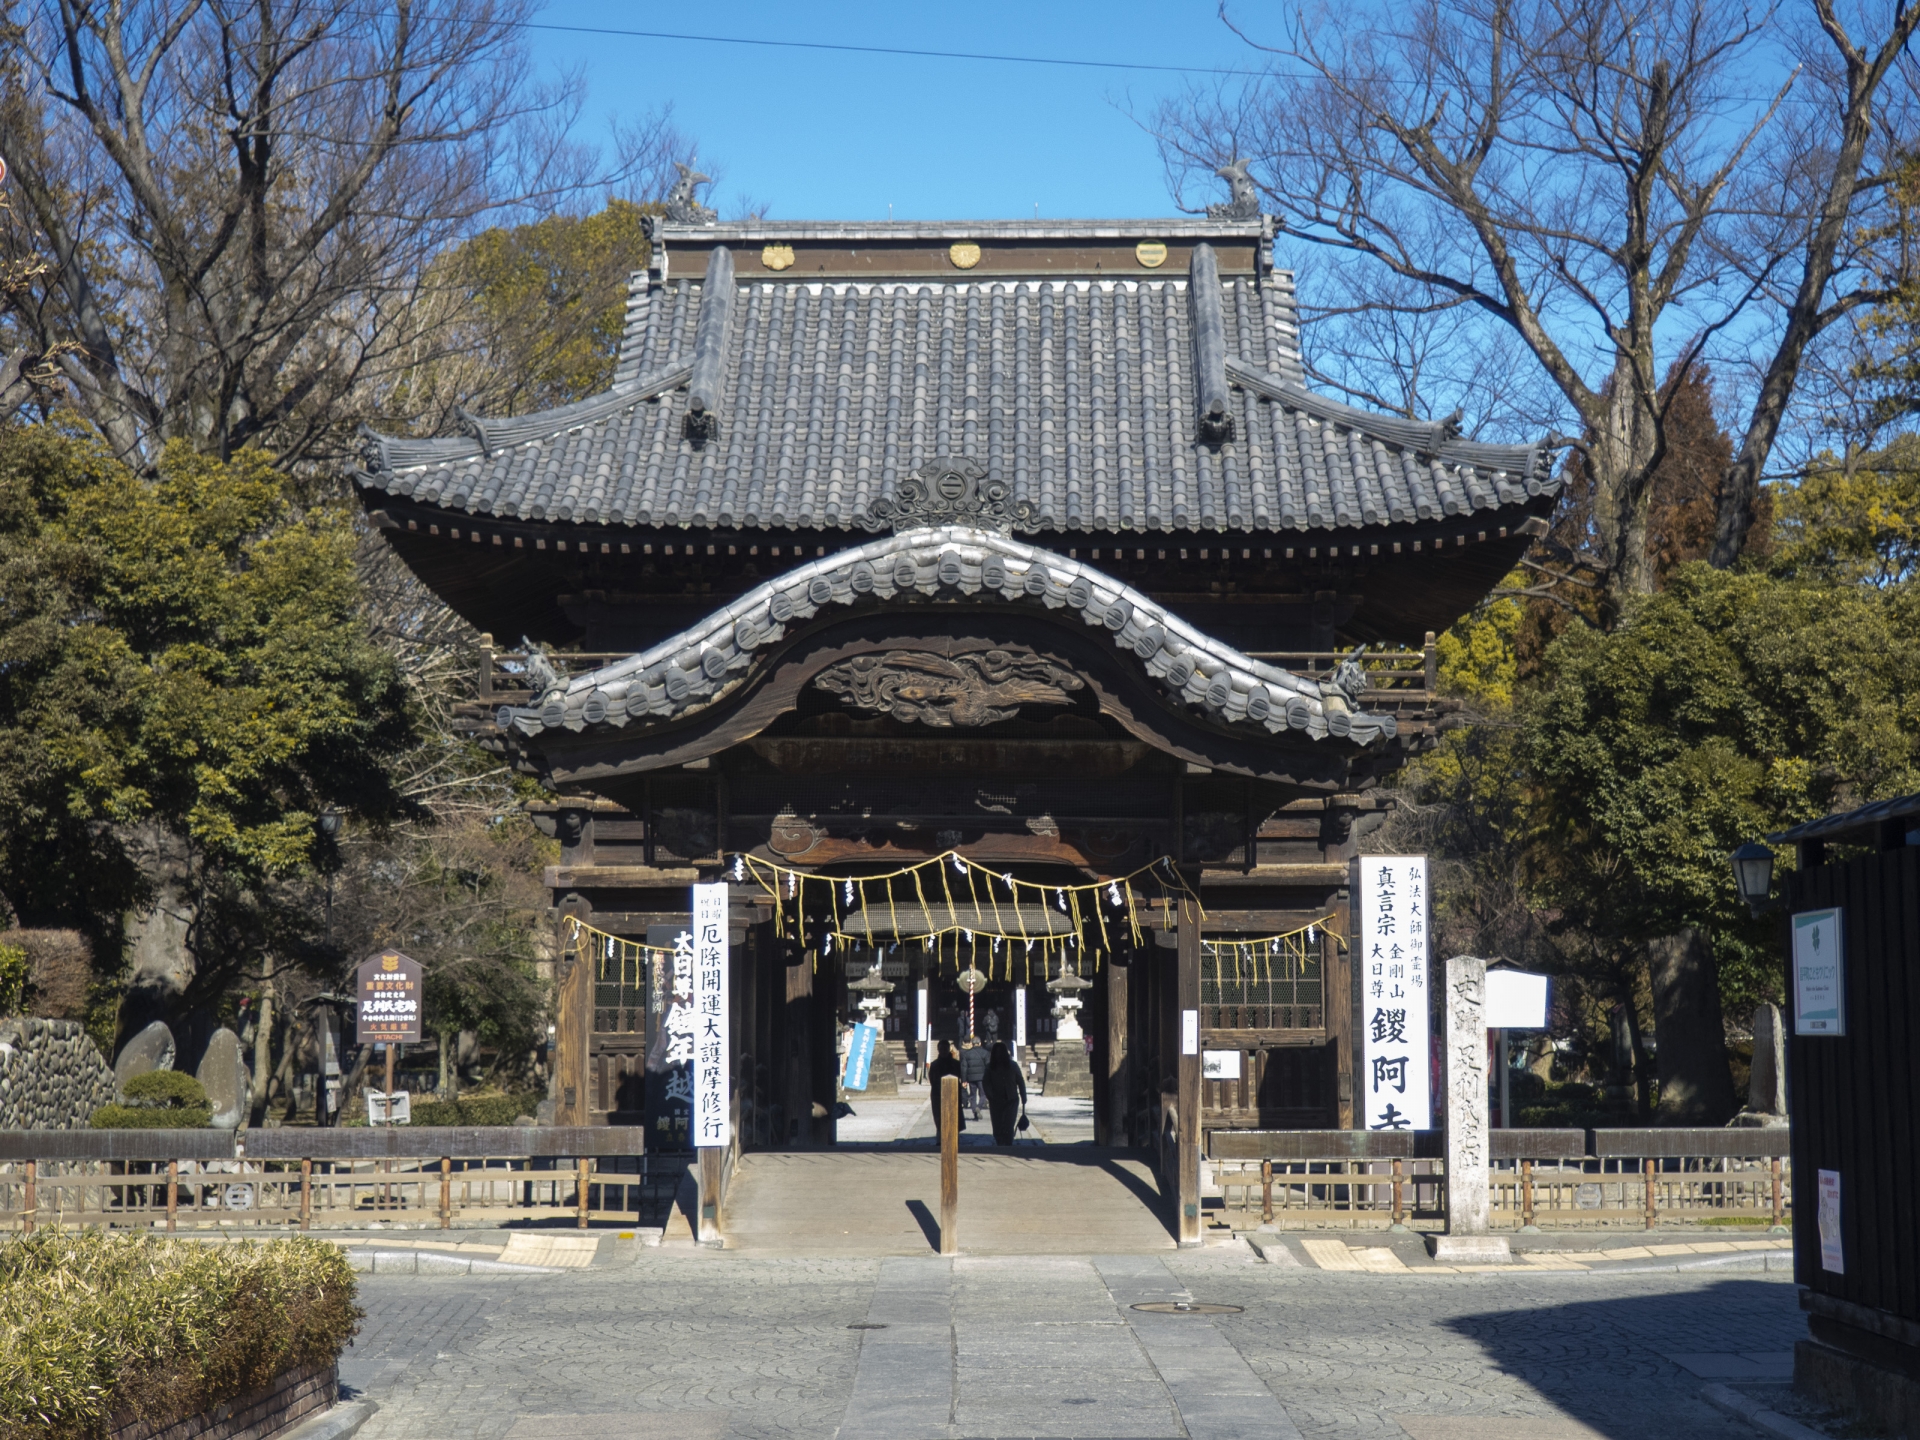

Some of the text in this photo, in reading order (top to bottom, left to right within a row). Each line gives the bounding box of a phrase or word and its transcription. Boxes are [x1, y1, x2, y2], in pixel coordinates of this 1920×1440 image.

[1377, 866, 1396, 936] 真言宗
[1409, 866, 1423, 988] 弘法大師御霊場
[366, 982, 414, 990] 重要文化財
[1370, 943, 1384, 999] 大日尊
[1389, 943, 1405, 999] 金剛山
[700, 923, 723, 1138] 厄除開運大護摩修行
